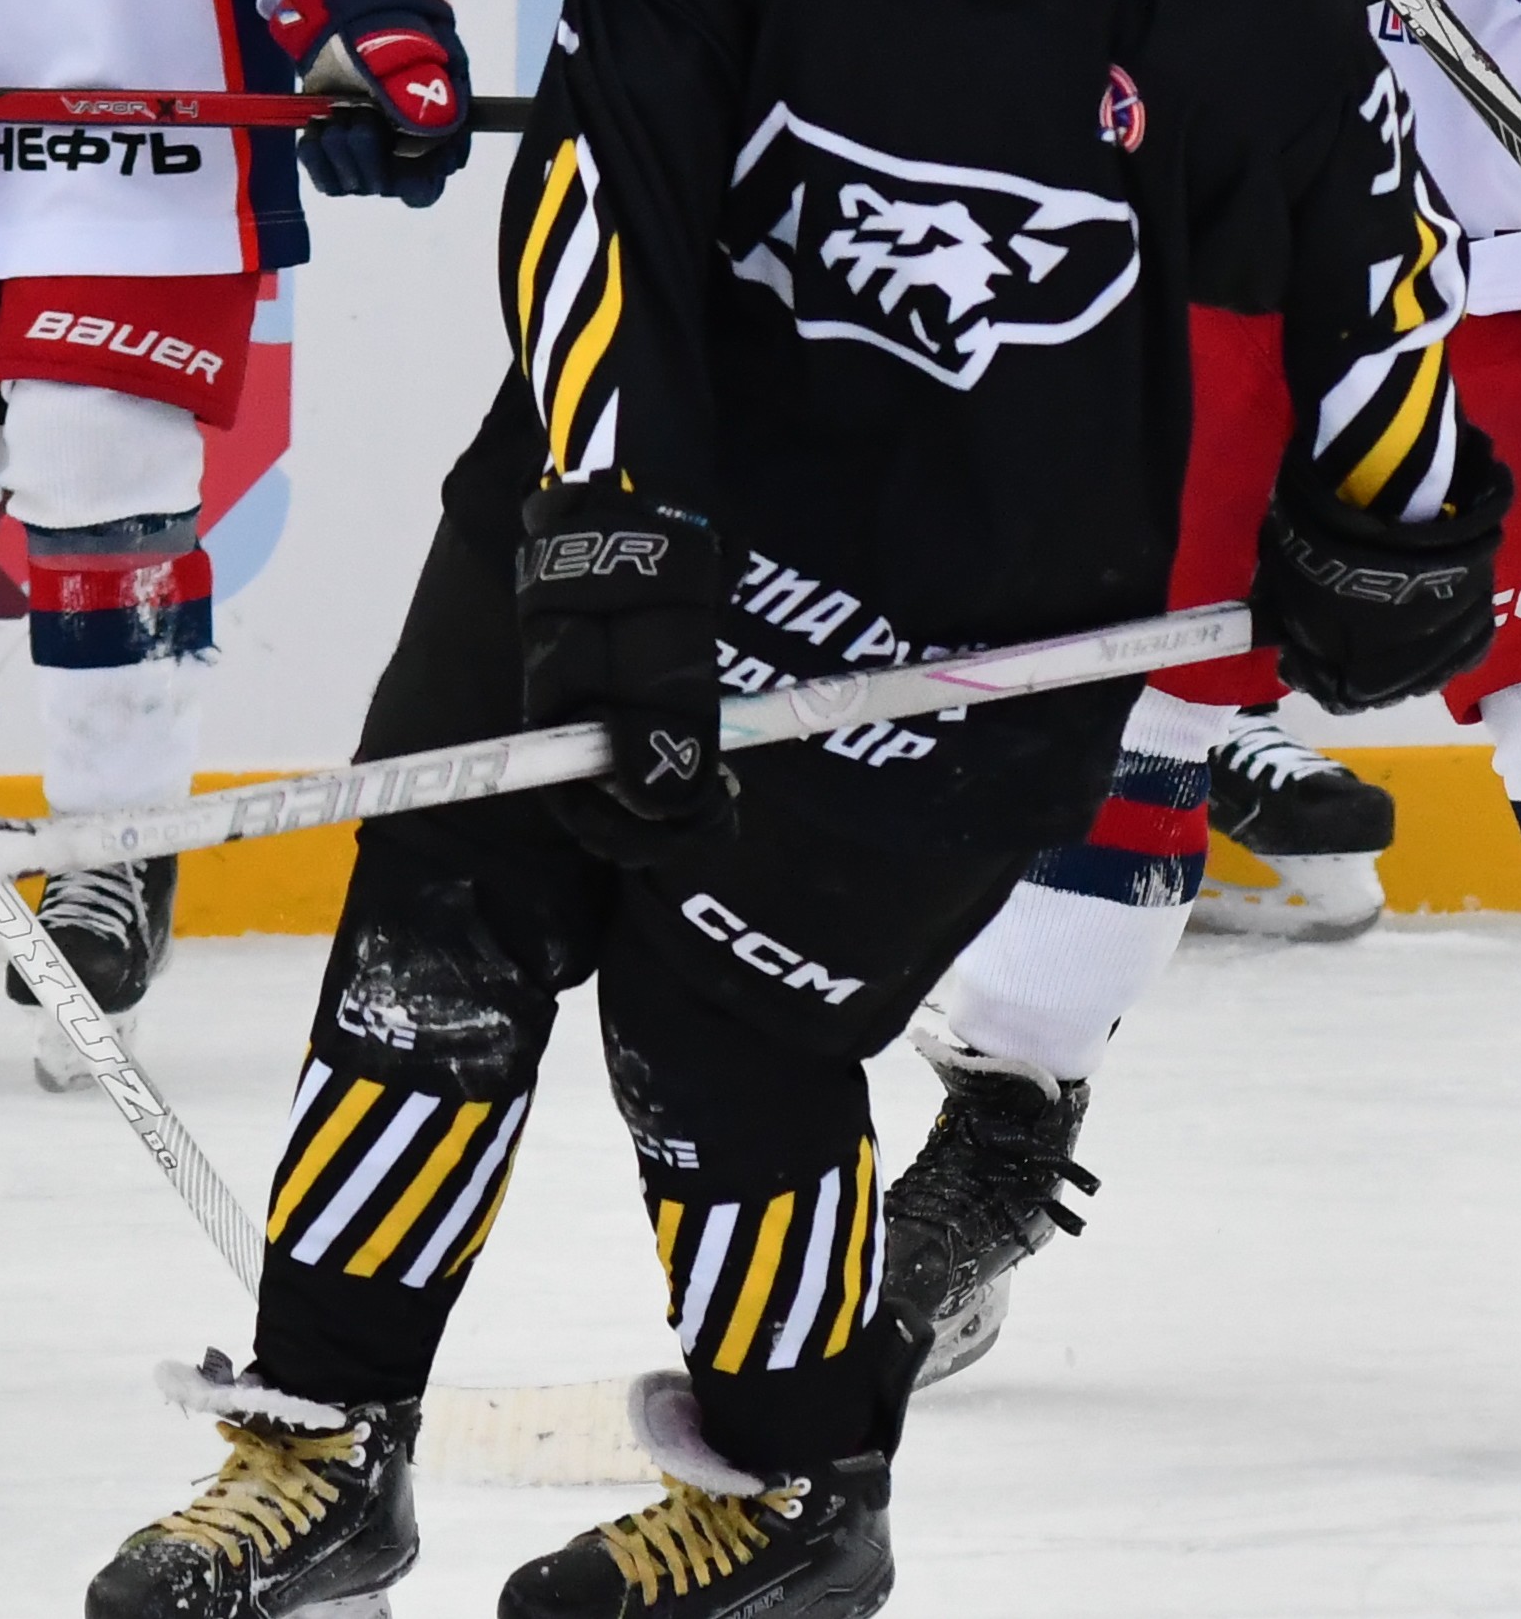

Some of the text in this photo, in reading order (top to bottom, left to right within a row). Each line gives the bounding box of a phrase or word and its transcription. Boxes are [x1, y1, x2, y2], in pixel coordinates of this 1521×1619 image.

[26, 309, 224, 384] BAUER
[681, 894, 865, 1004] CCM
[142, 1130, 177, 1169] BC
